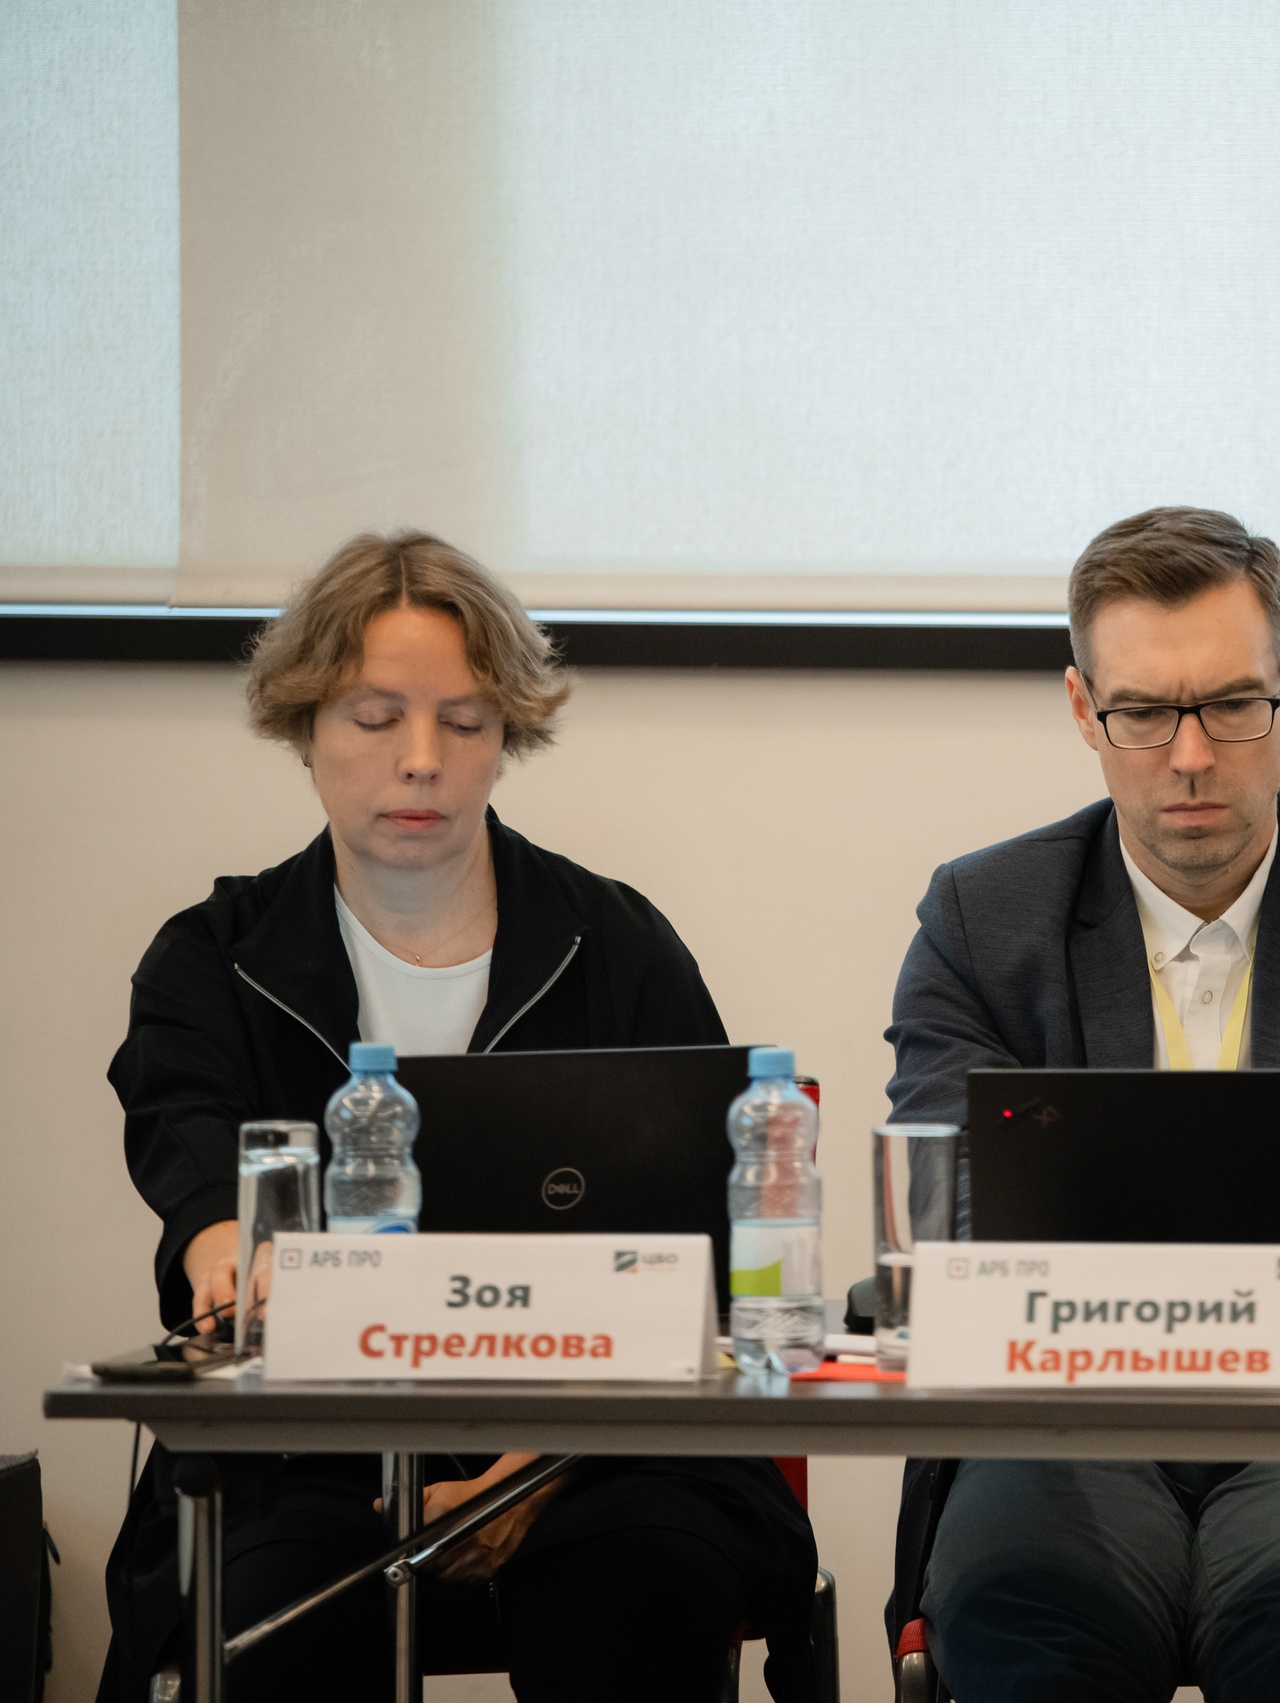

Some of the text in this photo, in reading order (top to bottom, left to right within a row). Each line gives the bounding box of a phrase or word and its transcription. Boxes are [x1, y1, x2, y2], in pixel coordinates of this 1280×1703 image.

[547, 1183, 580, 1195] DELL
[310, 1250, 382, 1267] АРБ ПРО
[446, 1275, 532, 1308] Зоя
[1026, 1288, 1256, 1334] Григорий
[359, 1323, 613, 1369] Стрелкова
[1006, 1339, 1271, 1384] Карлышев
